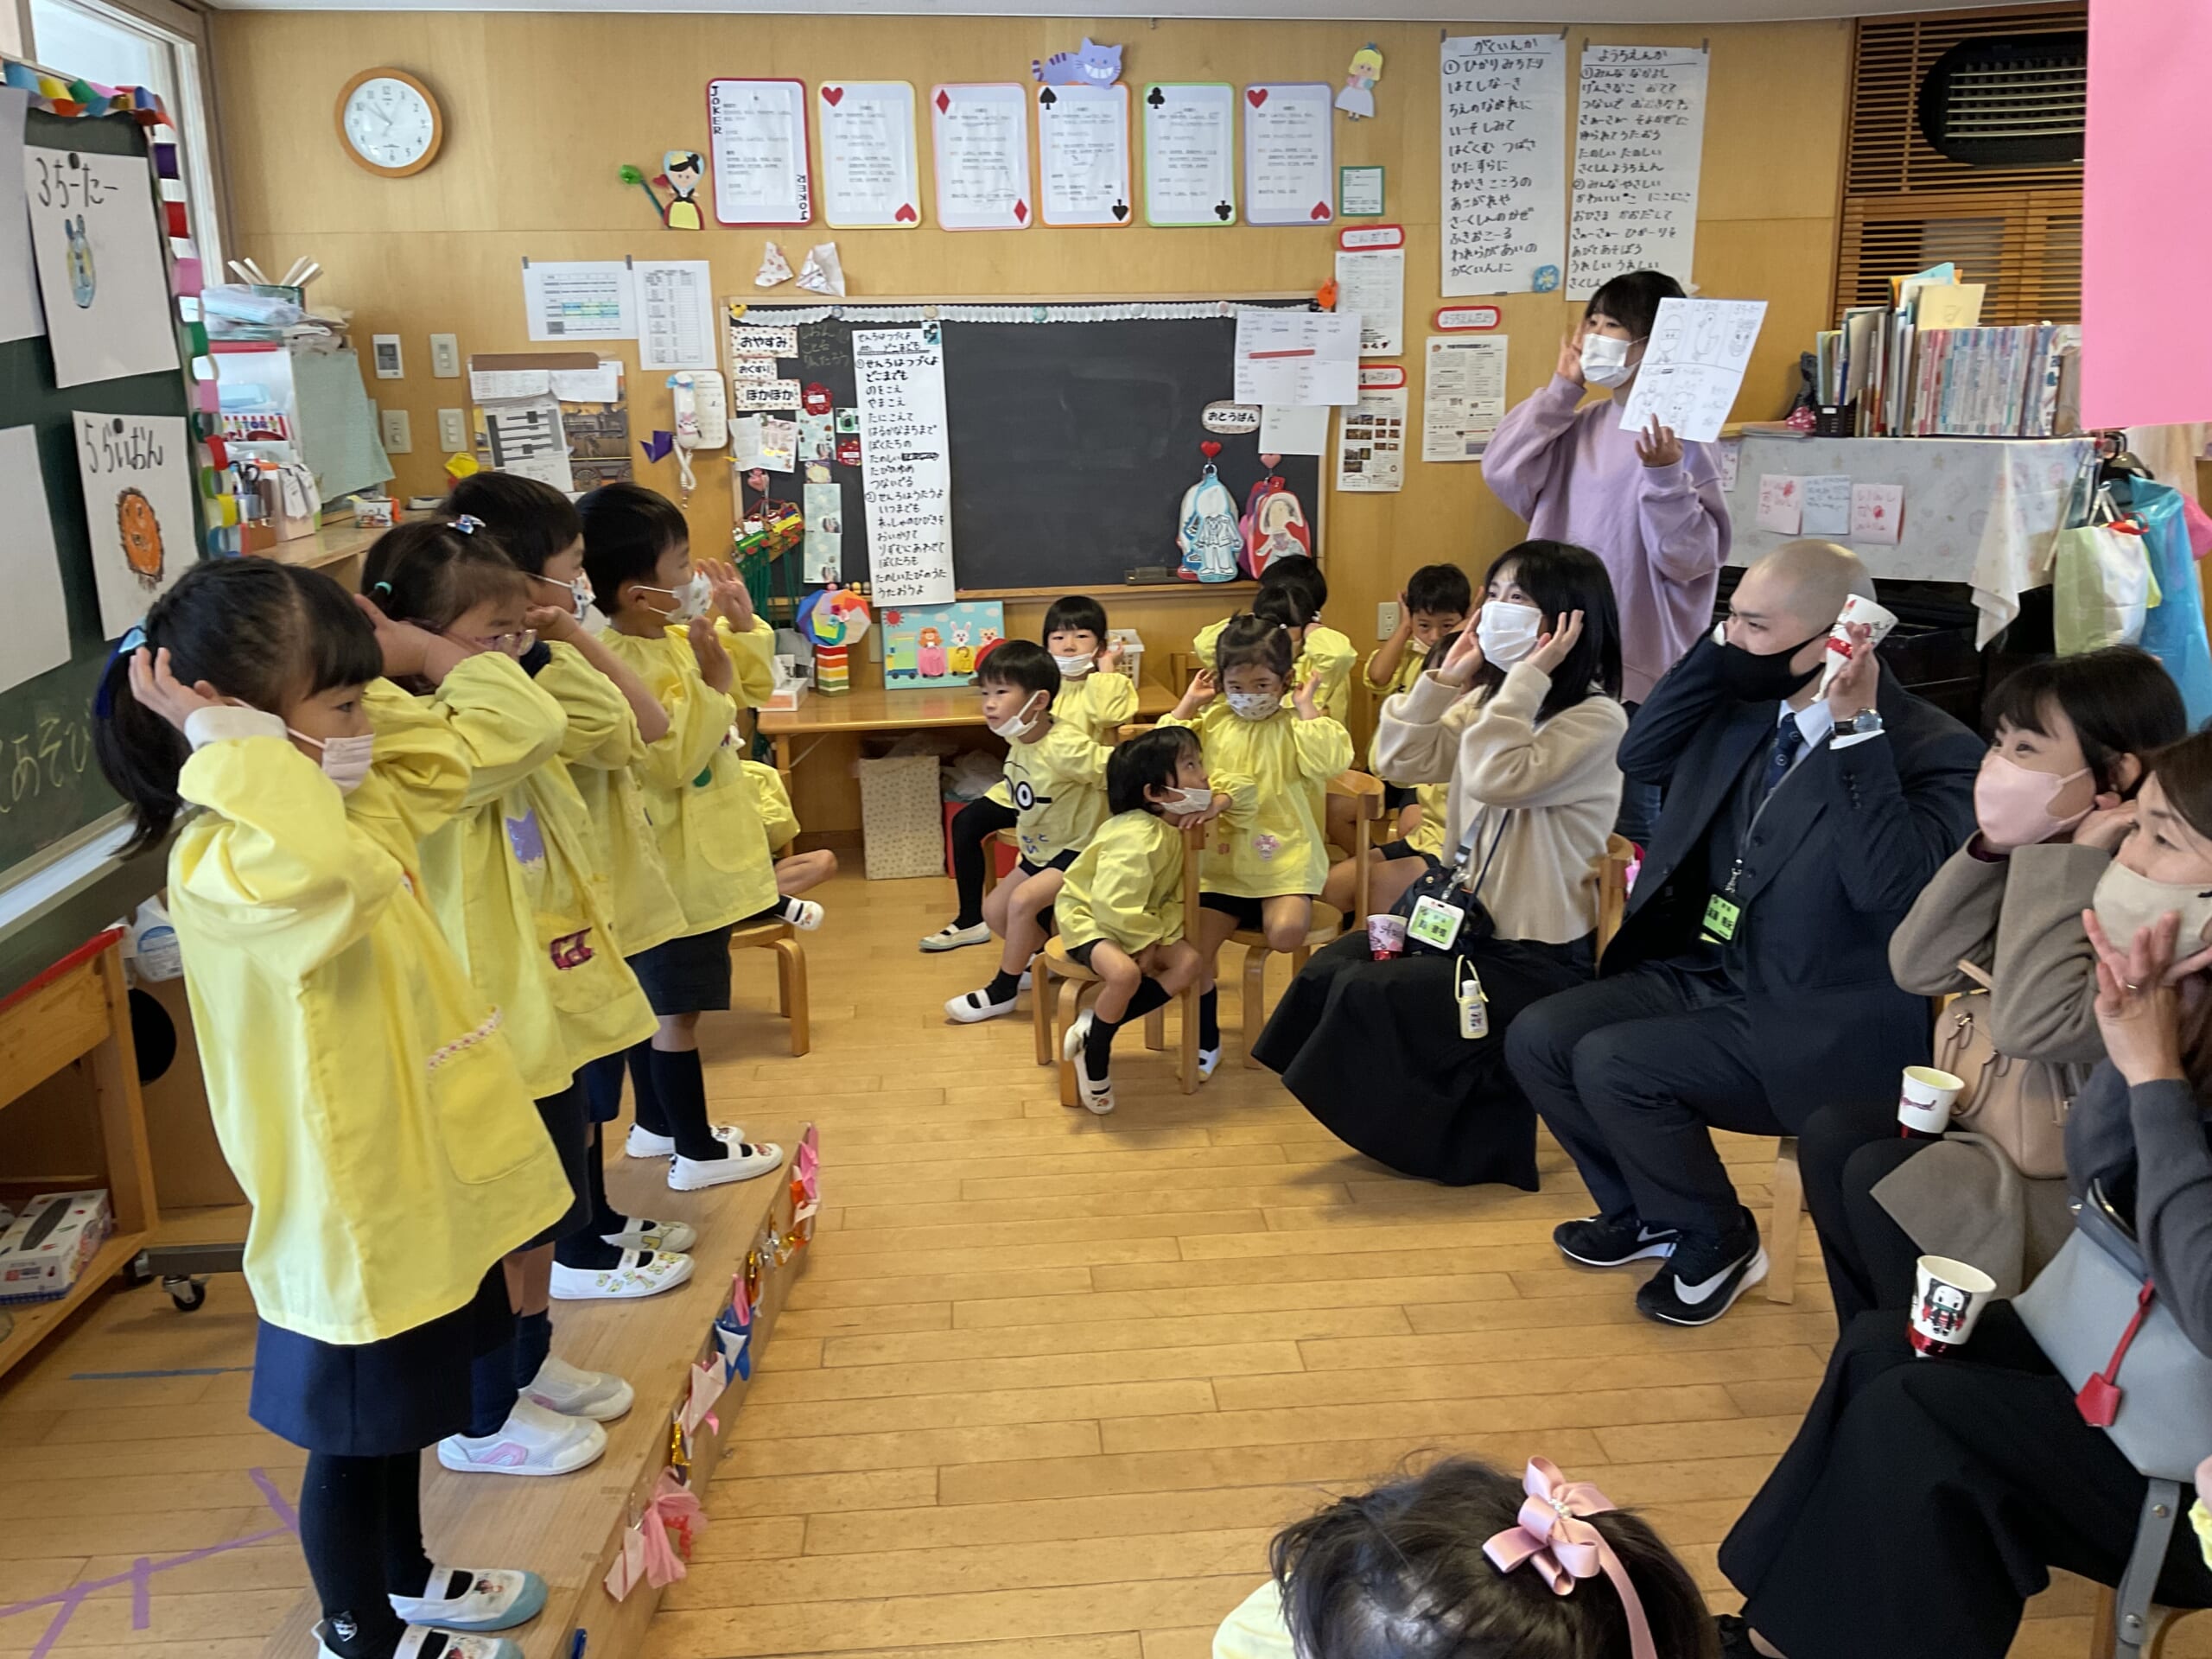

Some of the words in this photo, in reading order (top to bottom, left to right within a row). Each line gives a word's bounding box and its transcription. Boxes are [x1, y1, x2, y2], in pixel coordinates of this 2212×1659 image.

[710, 86, 721, 135] JOKER
[740, 335, 788, 348] おやすみ
[738, 365, 772, 374] おくすり
[866, 369, 909, 383] どこまでも
[746, 389, 794, 401] ほかほか
[1207, 411, 1257, 423] おとうばん
